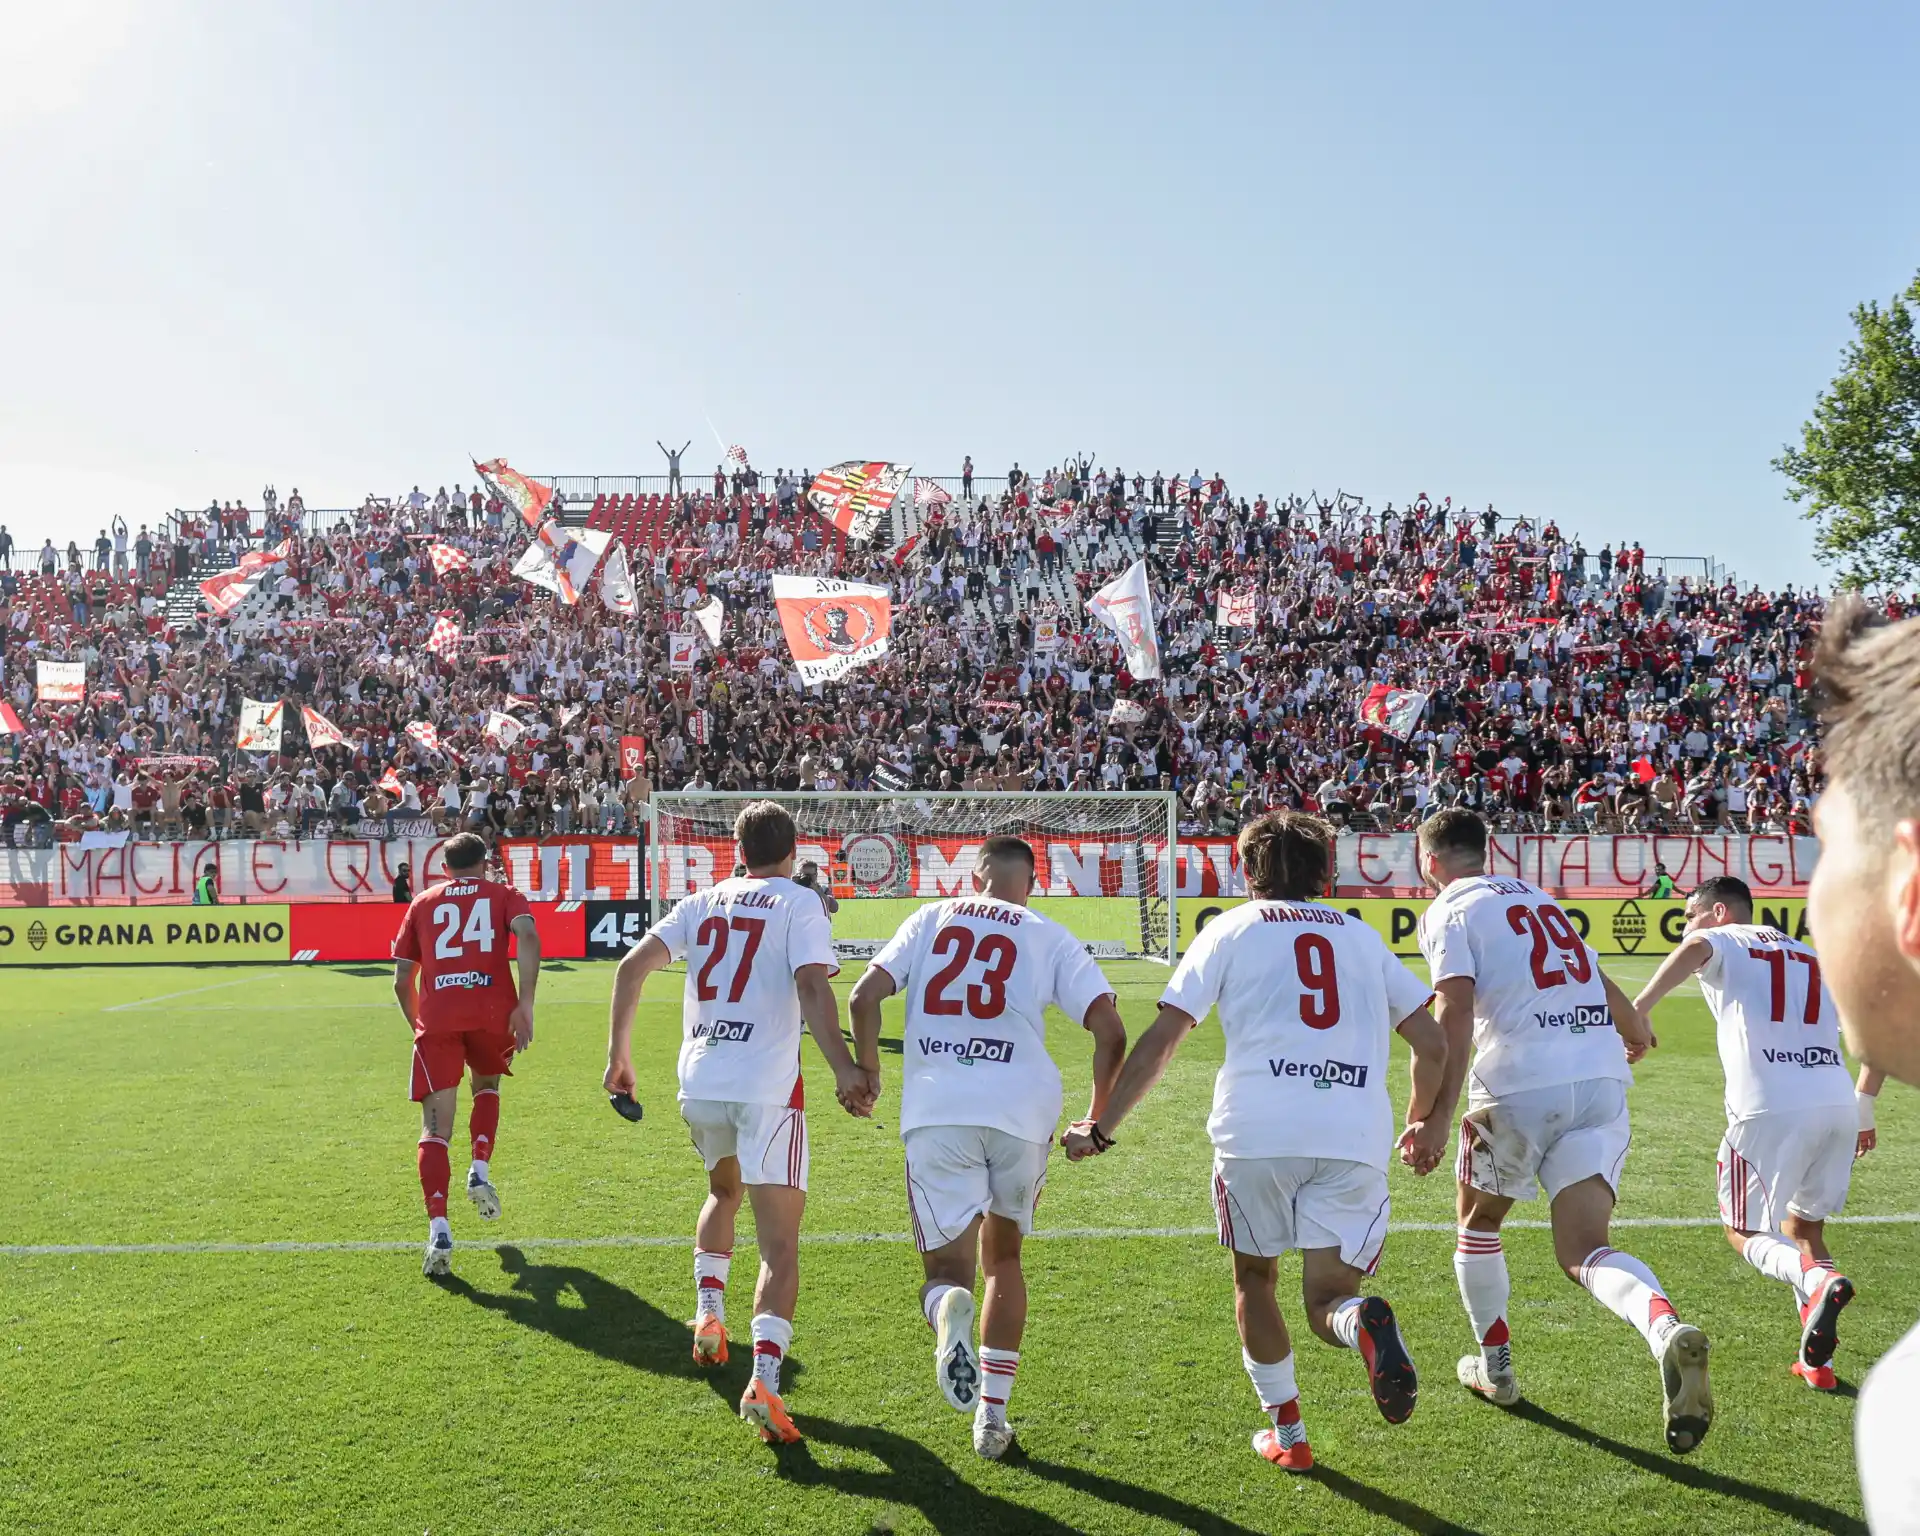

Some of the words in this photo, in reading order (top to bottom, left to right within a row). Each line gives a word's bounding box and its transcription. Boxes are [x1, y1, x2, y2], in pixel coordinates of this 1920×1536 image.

[816, 579, 849, 593] Noi
[445, 885, 478, 896] BARDI
[952, 902, 1022, 926] MARRAS
[1260, 908, 1345, 926] MANCUSO
[55, 924, 154, 946] GRANA
[166, 921, 284, 945] PADANO
[433, 898, 494, 960] 24
[697, 916, 765, 1003] 27
[1506, 905, 1592, 989] 29
[437, 971, 492, 987] VeroDol
[923, 926, 1018, 1019] 23
[1294, 933, 1341, 1030] 9
[1748, 947, 1821, 1024] 77
[1533, 1005, 1609, 1028] VeroDol
[918, 1037, 1013, 1062] VeroDol
[1762, 1047, 1837, 1064] VeroDol
[1268, 1059, 1367, 1088] VeroDol
